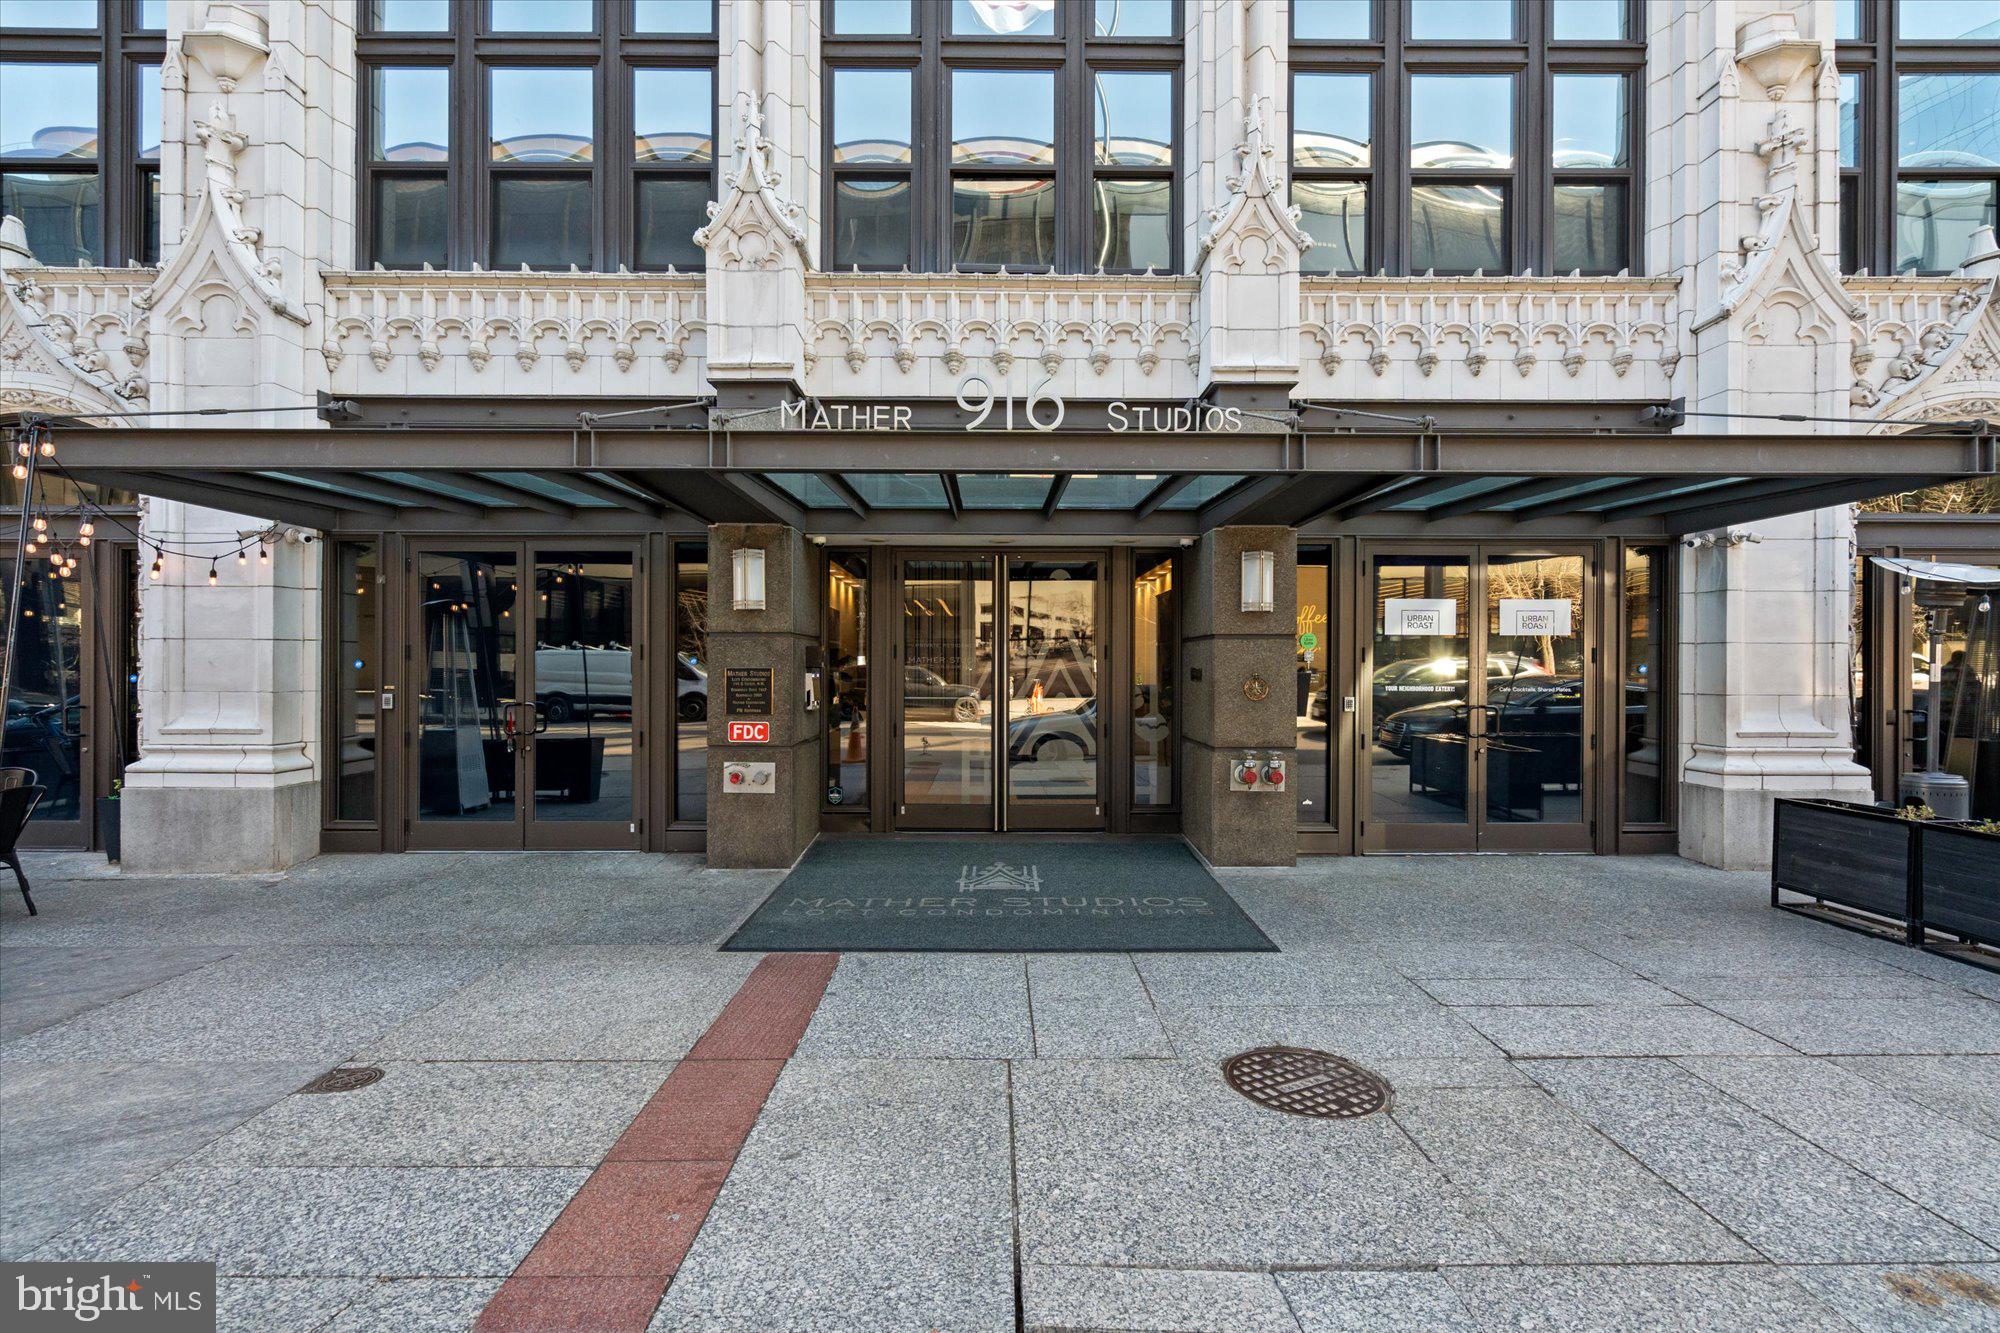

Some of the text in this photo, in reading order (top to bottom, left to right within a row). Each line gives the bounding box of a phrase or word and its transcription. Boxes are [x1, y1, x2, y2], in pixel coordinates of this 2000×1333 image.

[780, 373, 1243, 433] MATHER 916 STUDIOS
[1406, 614, 1434, 622] URBAN
[1521, 622, 1548, 630] ROAST
[906, 656, 945, 664] MATHER
[733, 725, 765, 739] FDC
[788, 897, 1209, 907] MATHER STUDIOS
[782, 908, 1216, 916] LOFT CONDOMINIUMS
